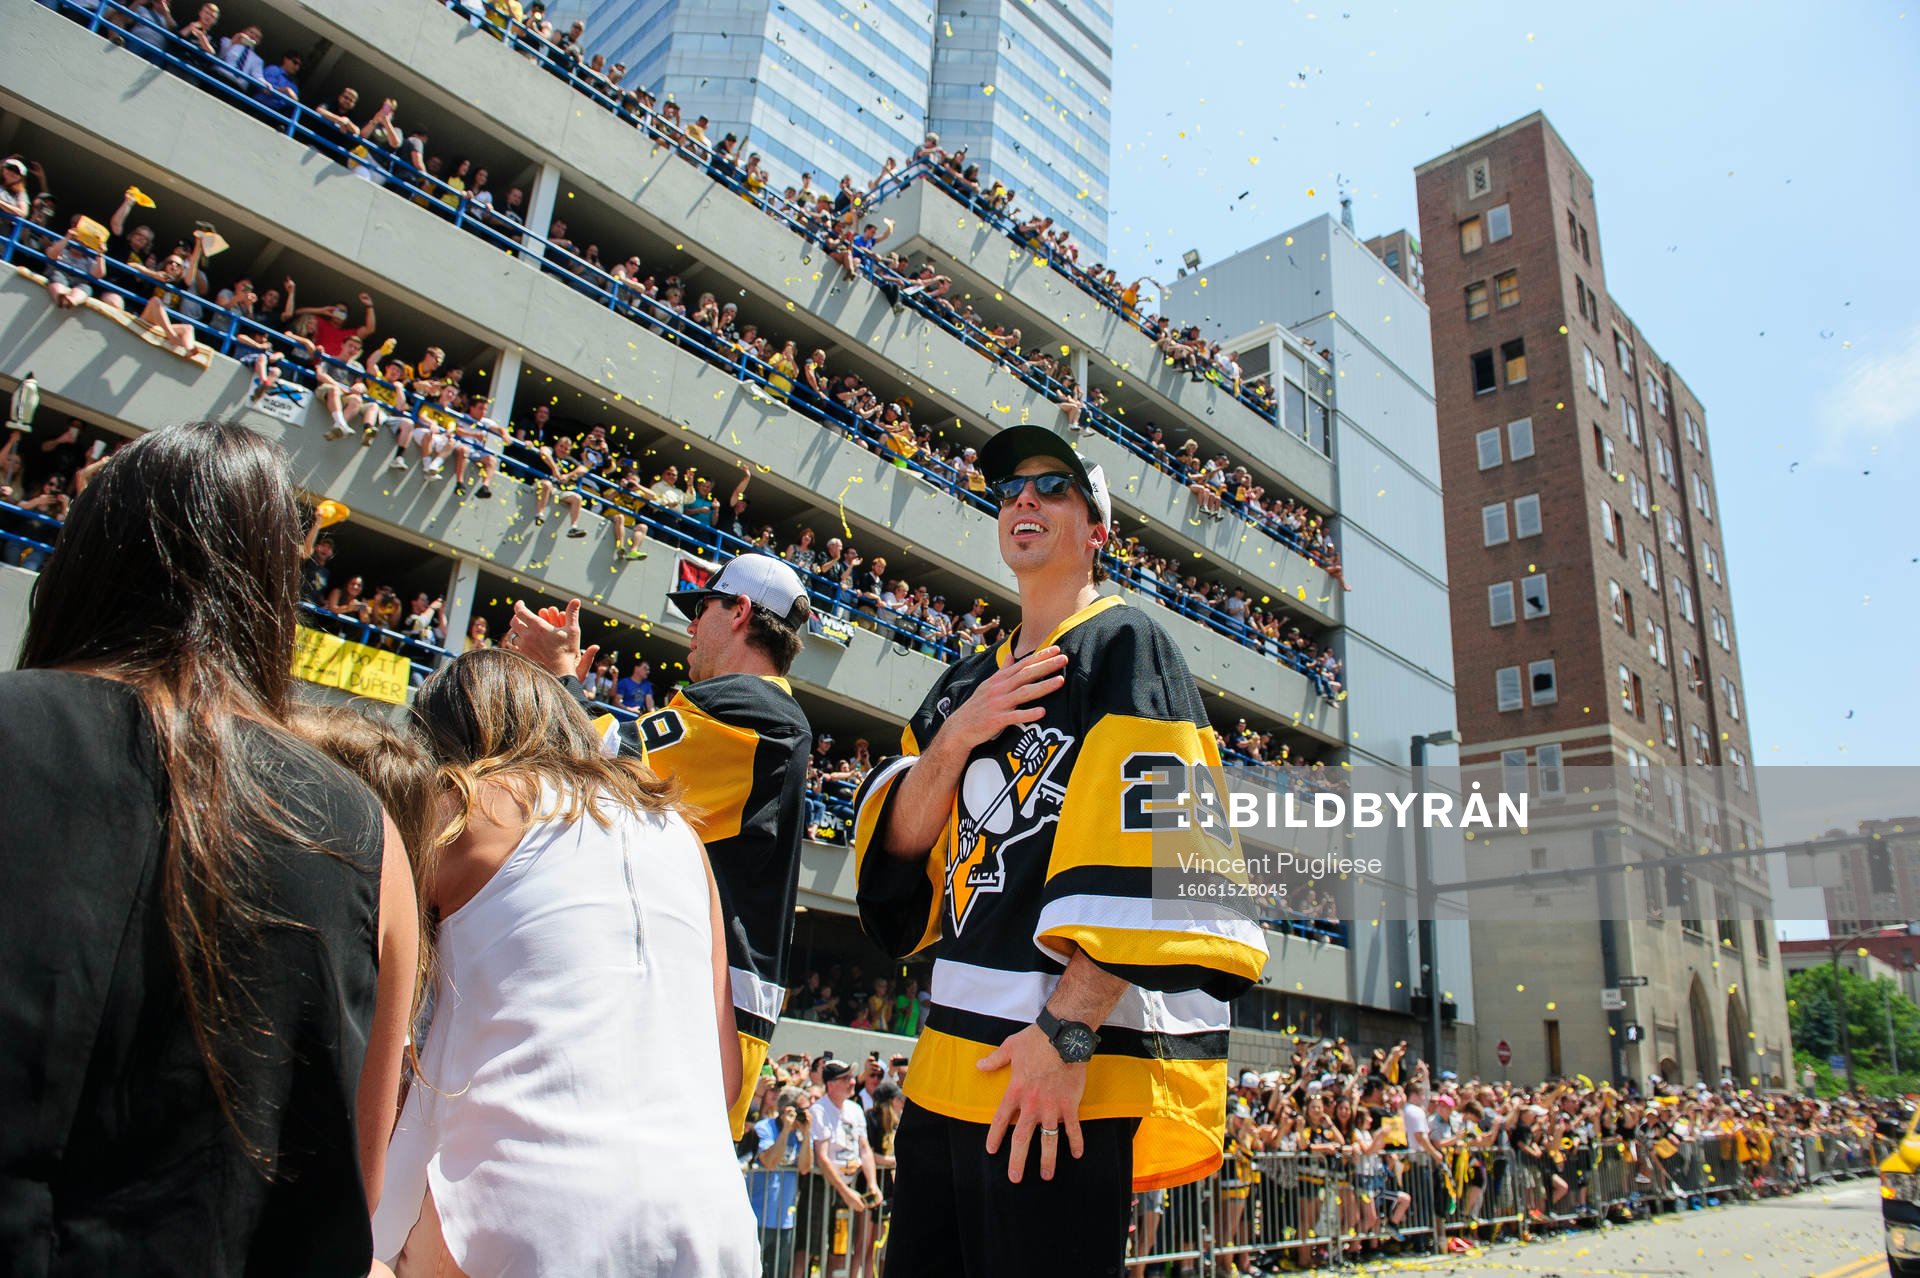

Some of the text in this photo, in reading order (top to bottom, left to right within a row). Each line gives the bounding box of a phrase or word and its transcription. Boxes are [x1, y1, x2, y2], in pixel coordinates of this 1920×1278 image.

[351, 649, 399, 676] DO IT
[350, 672, 401, 699] DUPER
[1120, 752, 1234, 849] 29
